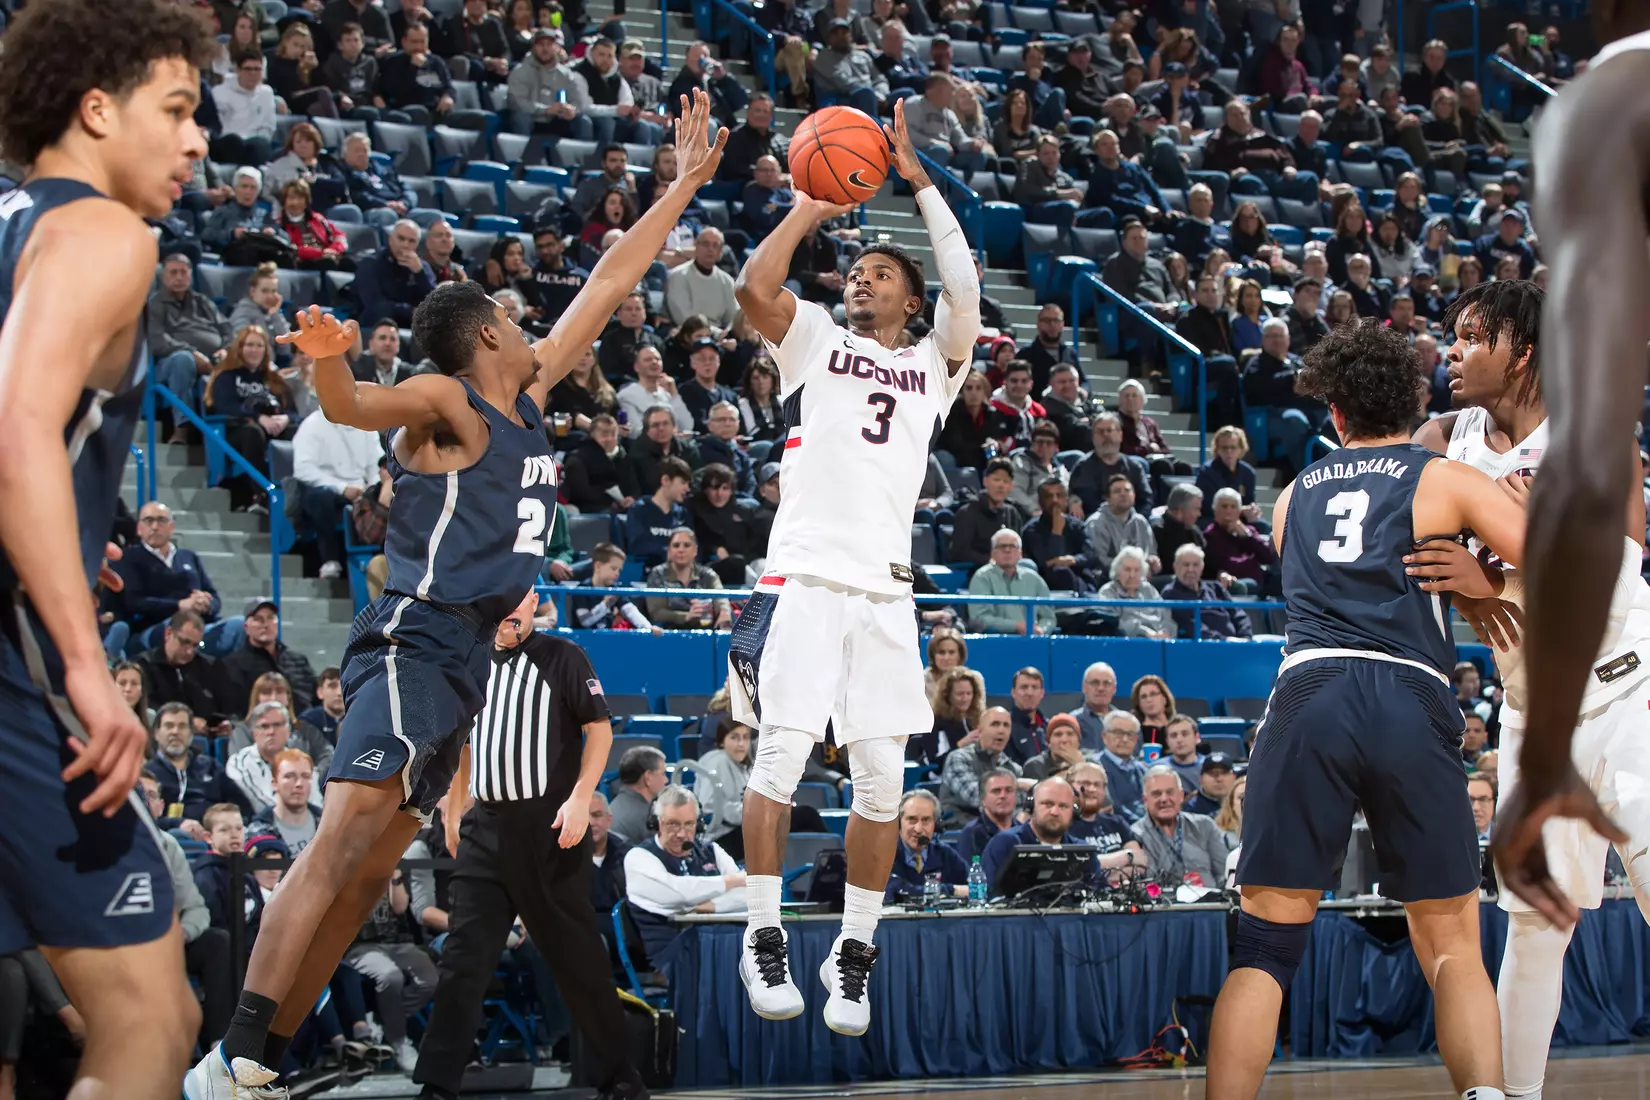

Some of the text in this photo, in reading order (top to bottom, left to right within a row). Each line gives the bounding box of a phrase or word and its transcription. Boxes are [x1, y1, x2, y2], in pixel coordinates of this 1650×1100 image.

[828, 350, 926, 395] UCONN
[861, 392, 897, 444] 3
[520, 454, 559, 490] UN
[1302, 457, 1409, 490] GUADARRAMA
[512, 497, 558, 557] 2
[1317, 488, 1370, 563] 3
